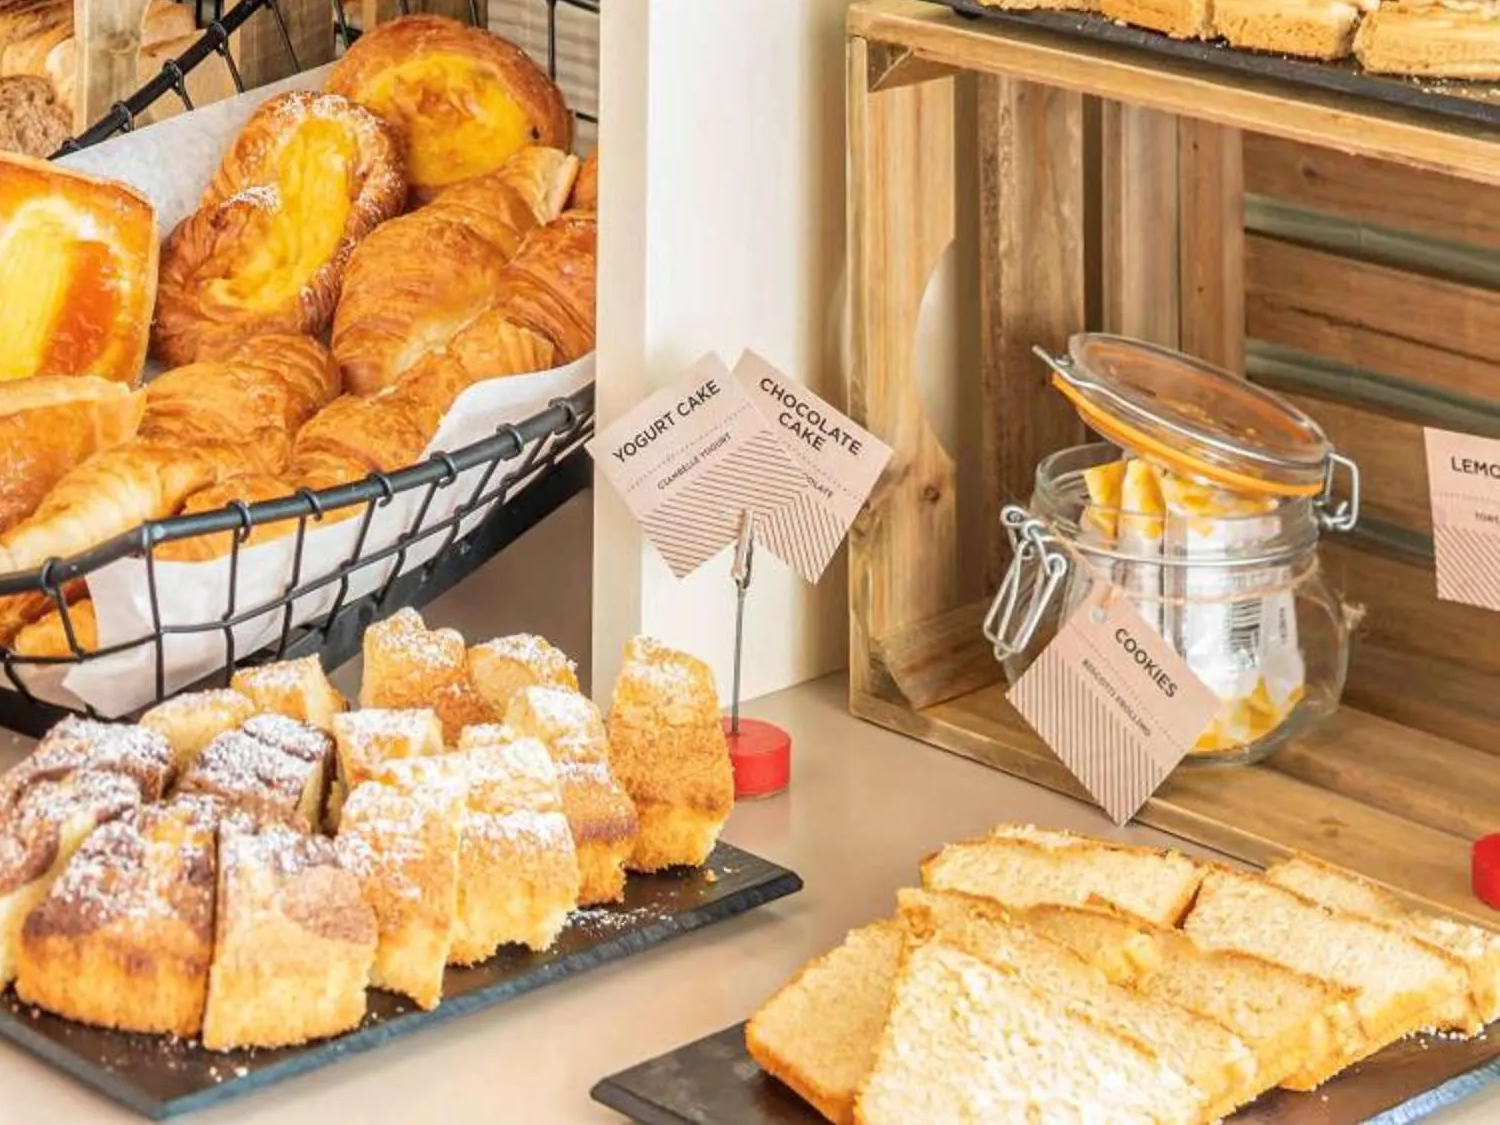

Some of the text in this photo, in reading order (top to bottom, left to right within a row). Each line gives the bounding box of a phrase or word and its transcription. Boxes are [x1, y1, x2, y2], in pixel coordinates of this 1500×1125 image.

[612, 379, 721, 463] YOGURT CAKE
[760, 377, 863, 456] CHOCOLATE
[778, 412, 825, 452] CAKE
[1115, 628, 1179, 698] COOKIES
